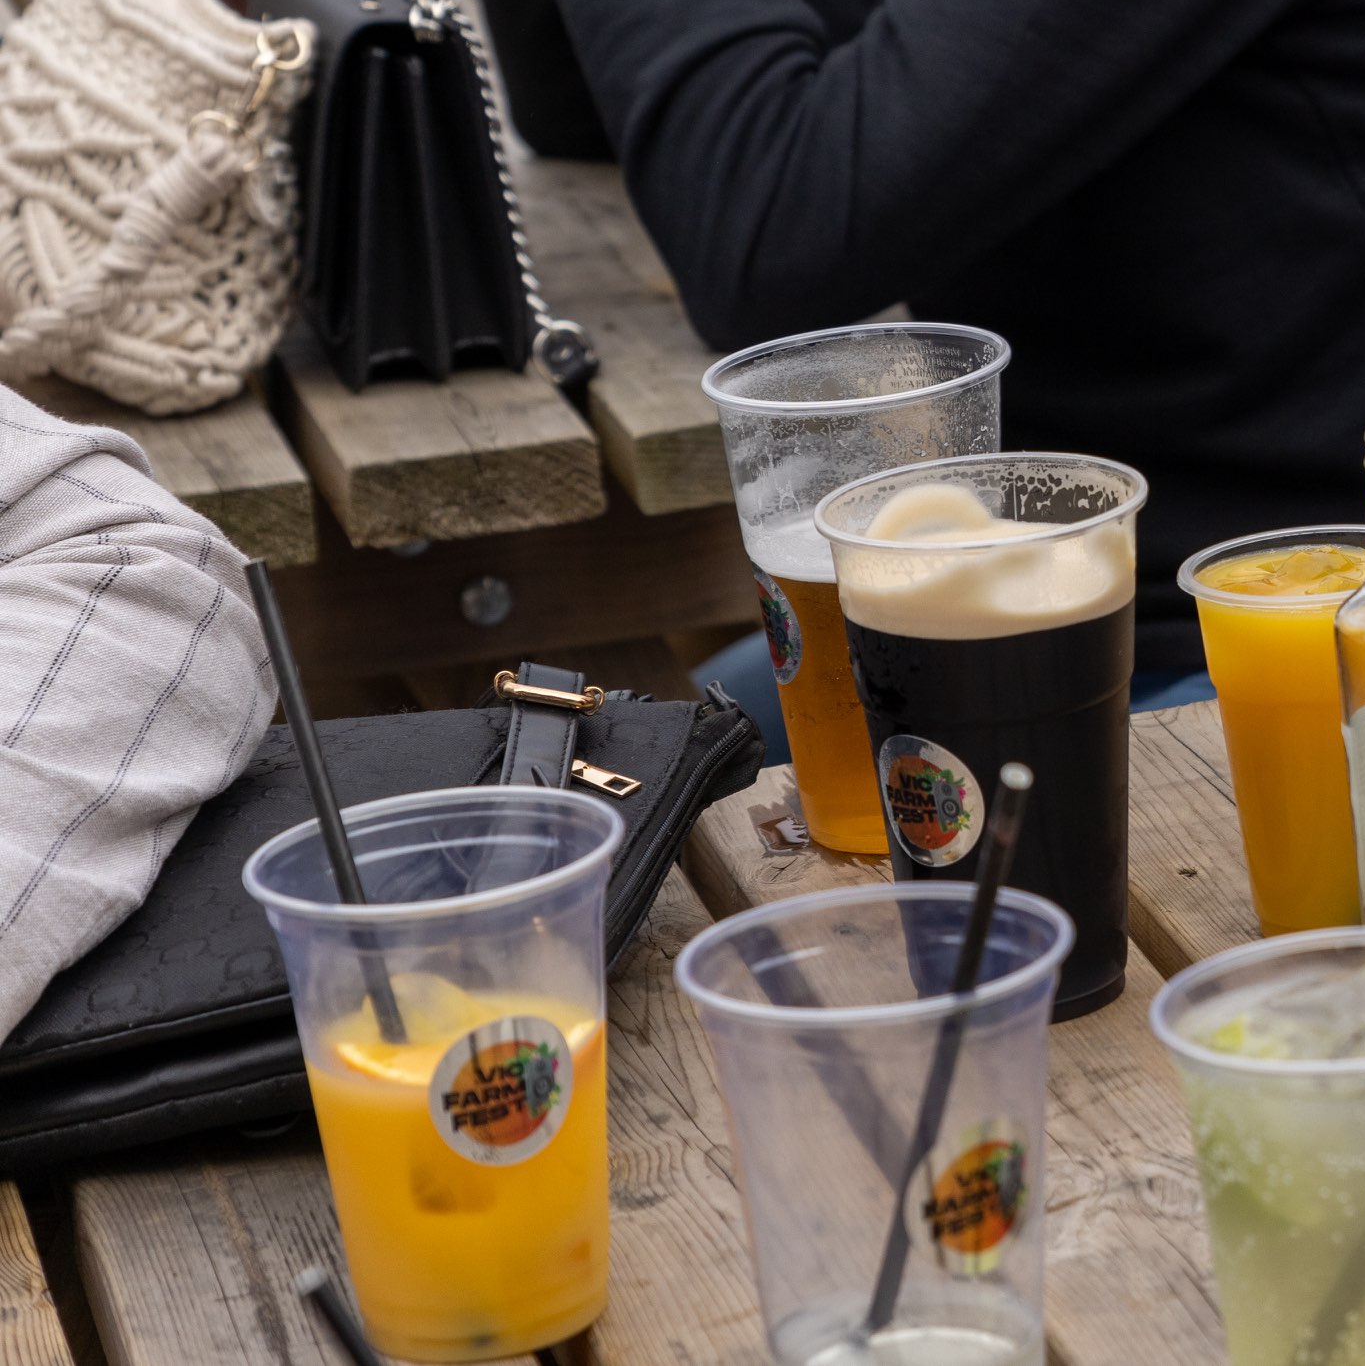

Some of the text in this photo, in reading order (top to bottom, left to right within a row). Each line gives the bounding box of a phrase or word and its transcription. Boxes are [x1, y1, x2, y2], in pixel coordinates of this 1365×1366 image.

[898, 772, 933, 792] VIC
[886, 784, 937, 807] FARM
[892, 804, 938, 824] FEST
[477, 1062, 524, 1084] VIC
[441, 1081, 528, 1113] FARM
[451, 1098, 527, 1134] FEST
